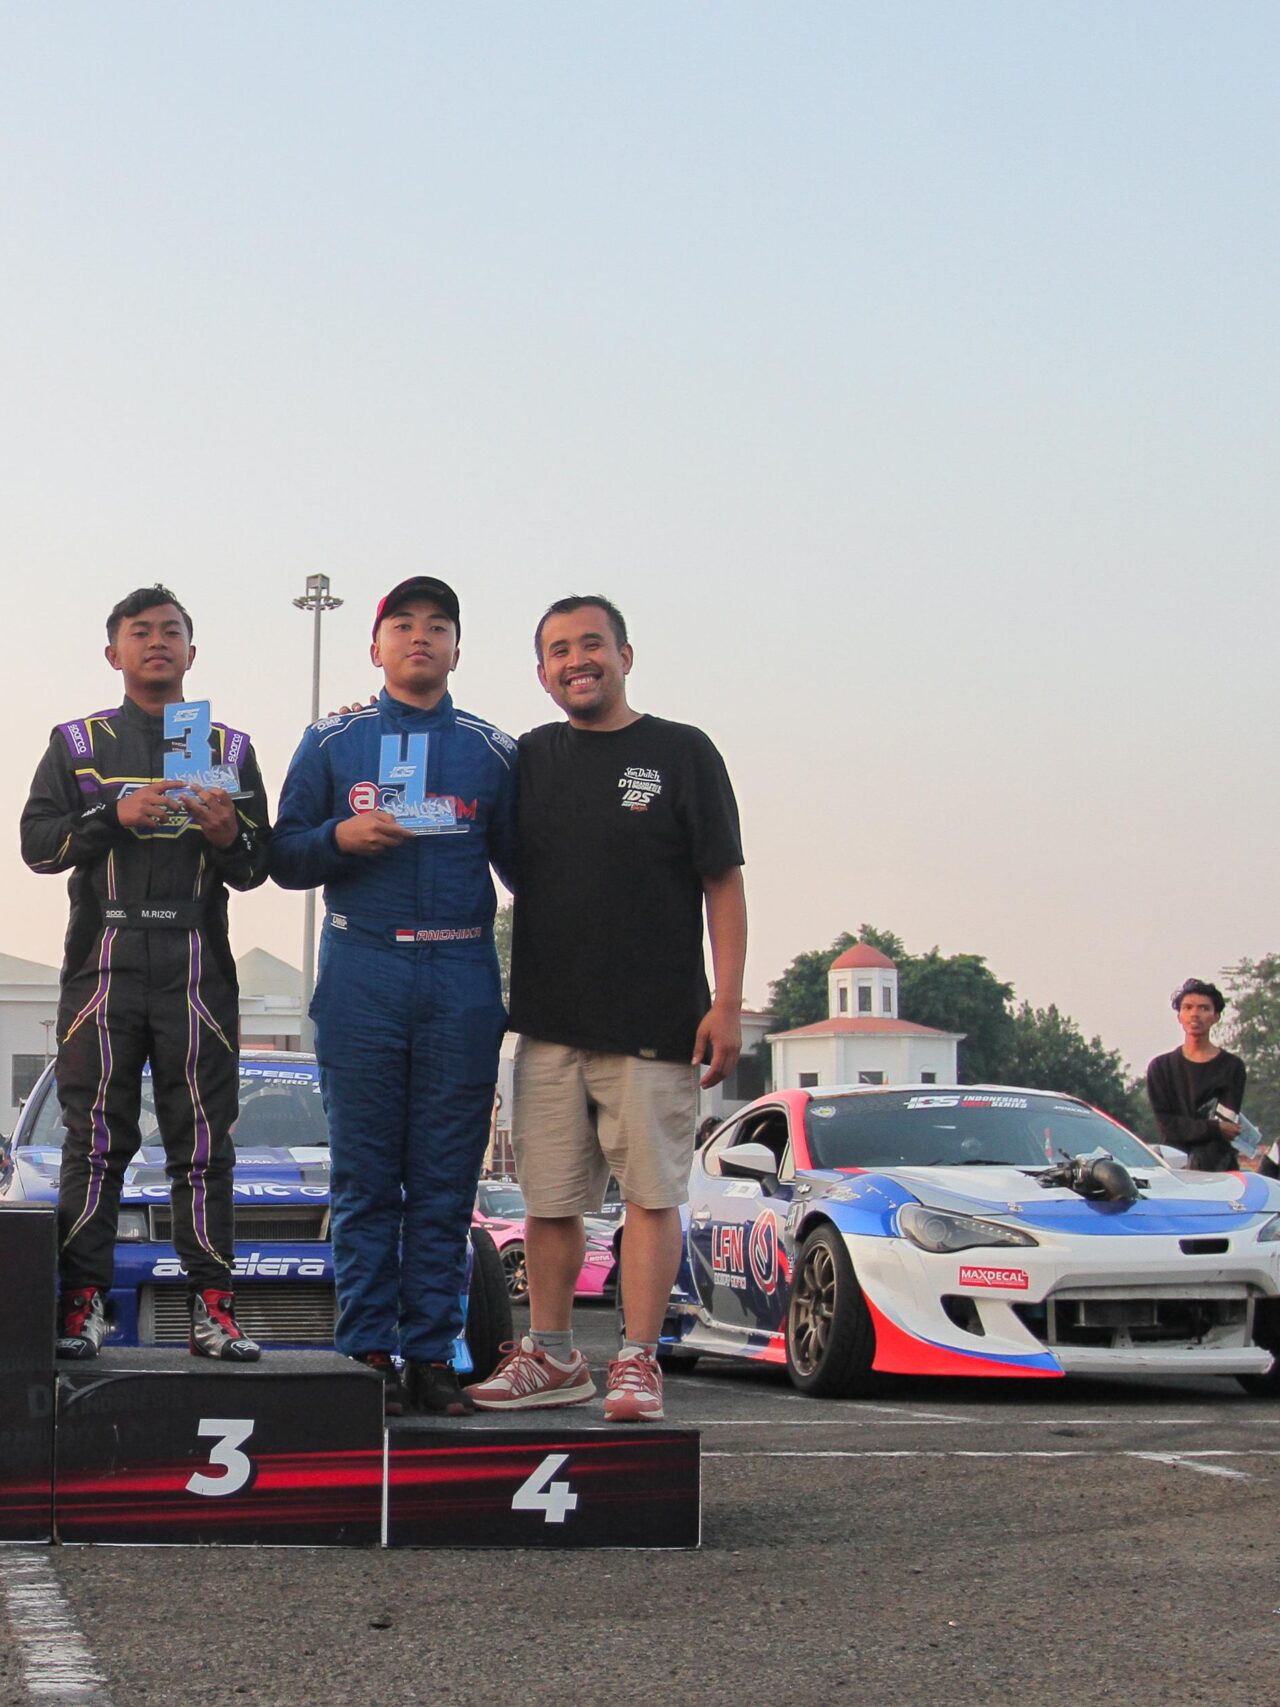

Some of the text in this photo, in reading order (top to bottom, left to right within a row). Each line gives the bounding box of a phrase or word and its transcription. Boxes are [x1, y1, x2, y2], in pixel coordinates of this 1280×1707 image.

[70, 724, 87, 753] sparco
[227, 733, 241, 763] sparco
[622, 789, 655, 804] IDS
[105, 909, 127, 918] spar
[711, 1225, 745, 1273] LFN
[961, 1269, 1025, 1286] MAXDECAL
[184, 1418, 256, 1497] 3
[511, 1454, 578, 1523] 4
